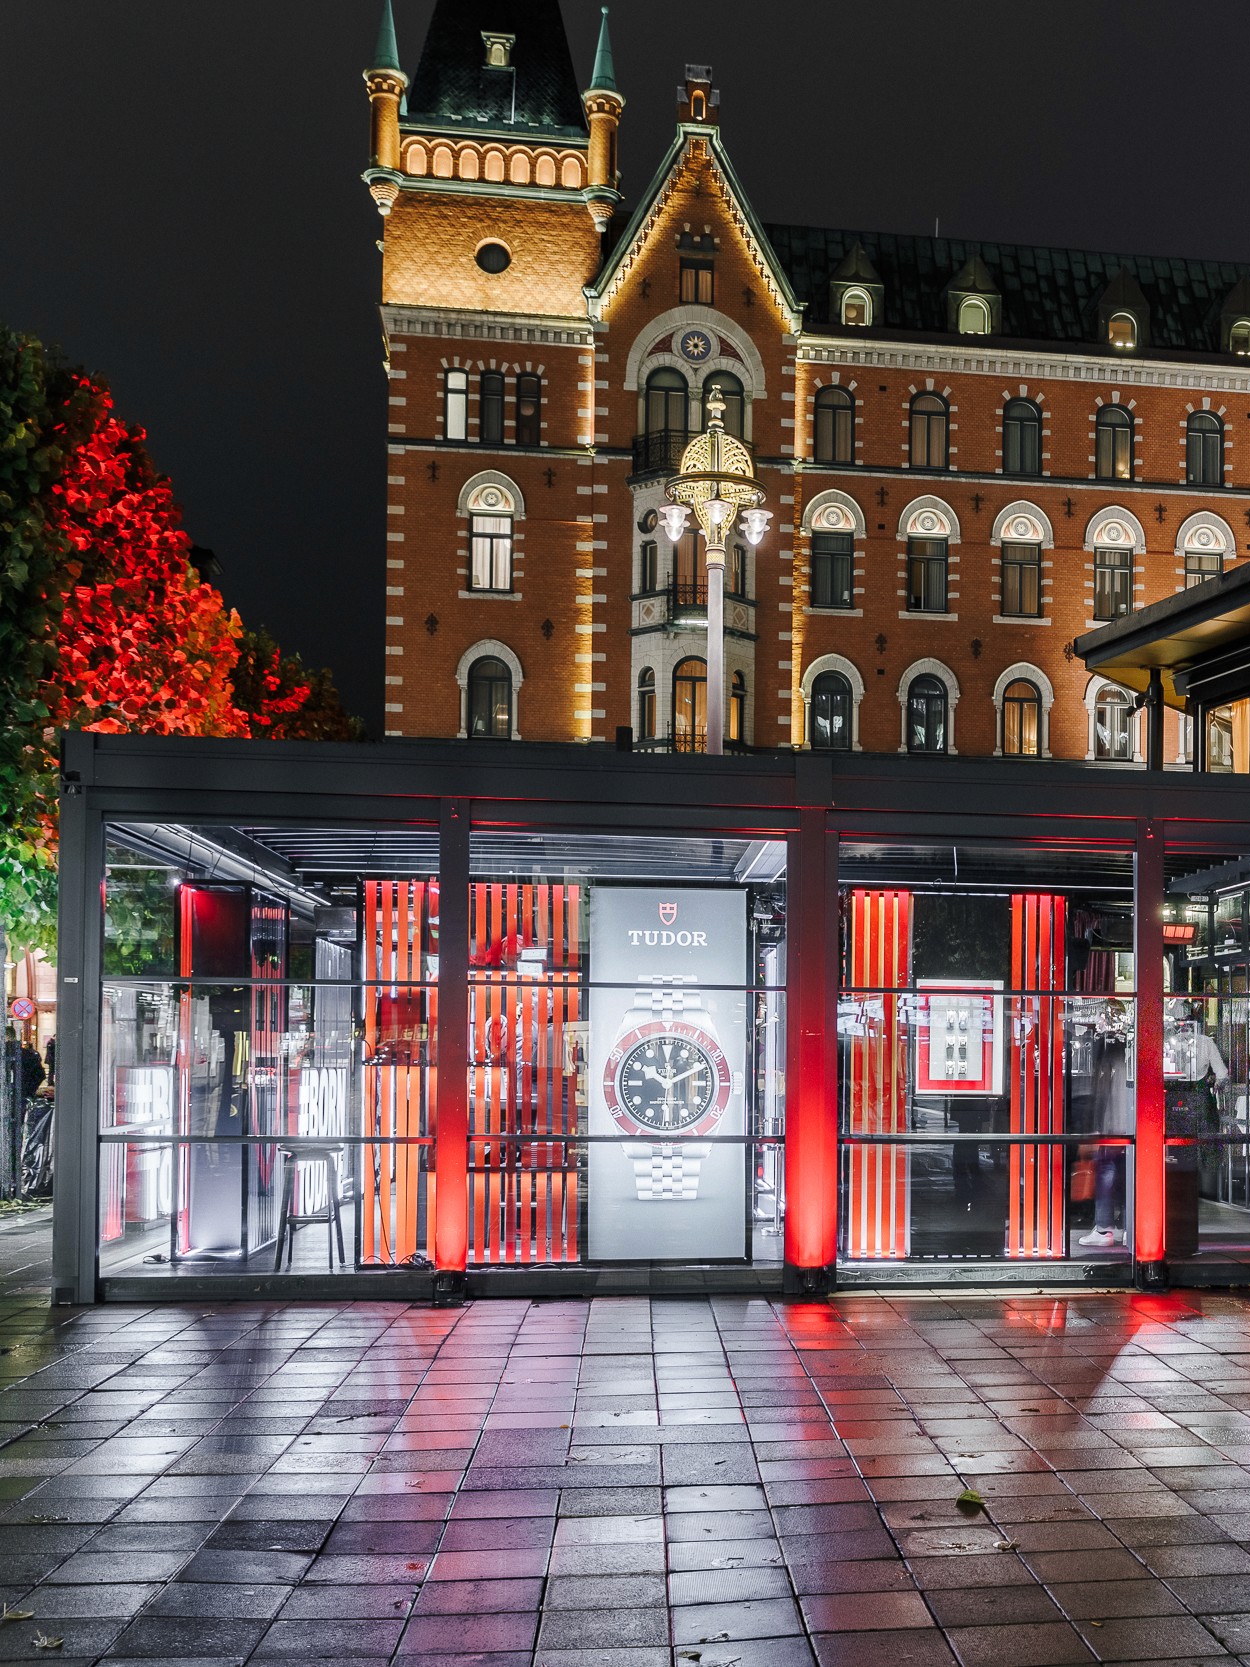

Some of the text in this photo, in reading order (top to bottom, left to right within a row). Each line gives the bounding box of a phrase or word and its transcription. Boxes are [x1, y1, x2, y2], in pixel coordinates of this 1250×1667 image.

[628, 930, 708, 946] TUDOR
[610, 1048, 623, 1062] 50
[714, 1049, 723, 1061] 10
[298, 1068, 346, 1136] #BORN
[611, 1106, 623, 1118] 40
[711, 1106, 723, 1118] 20
